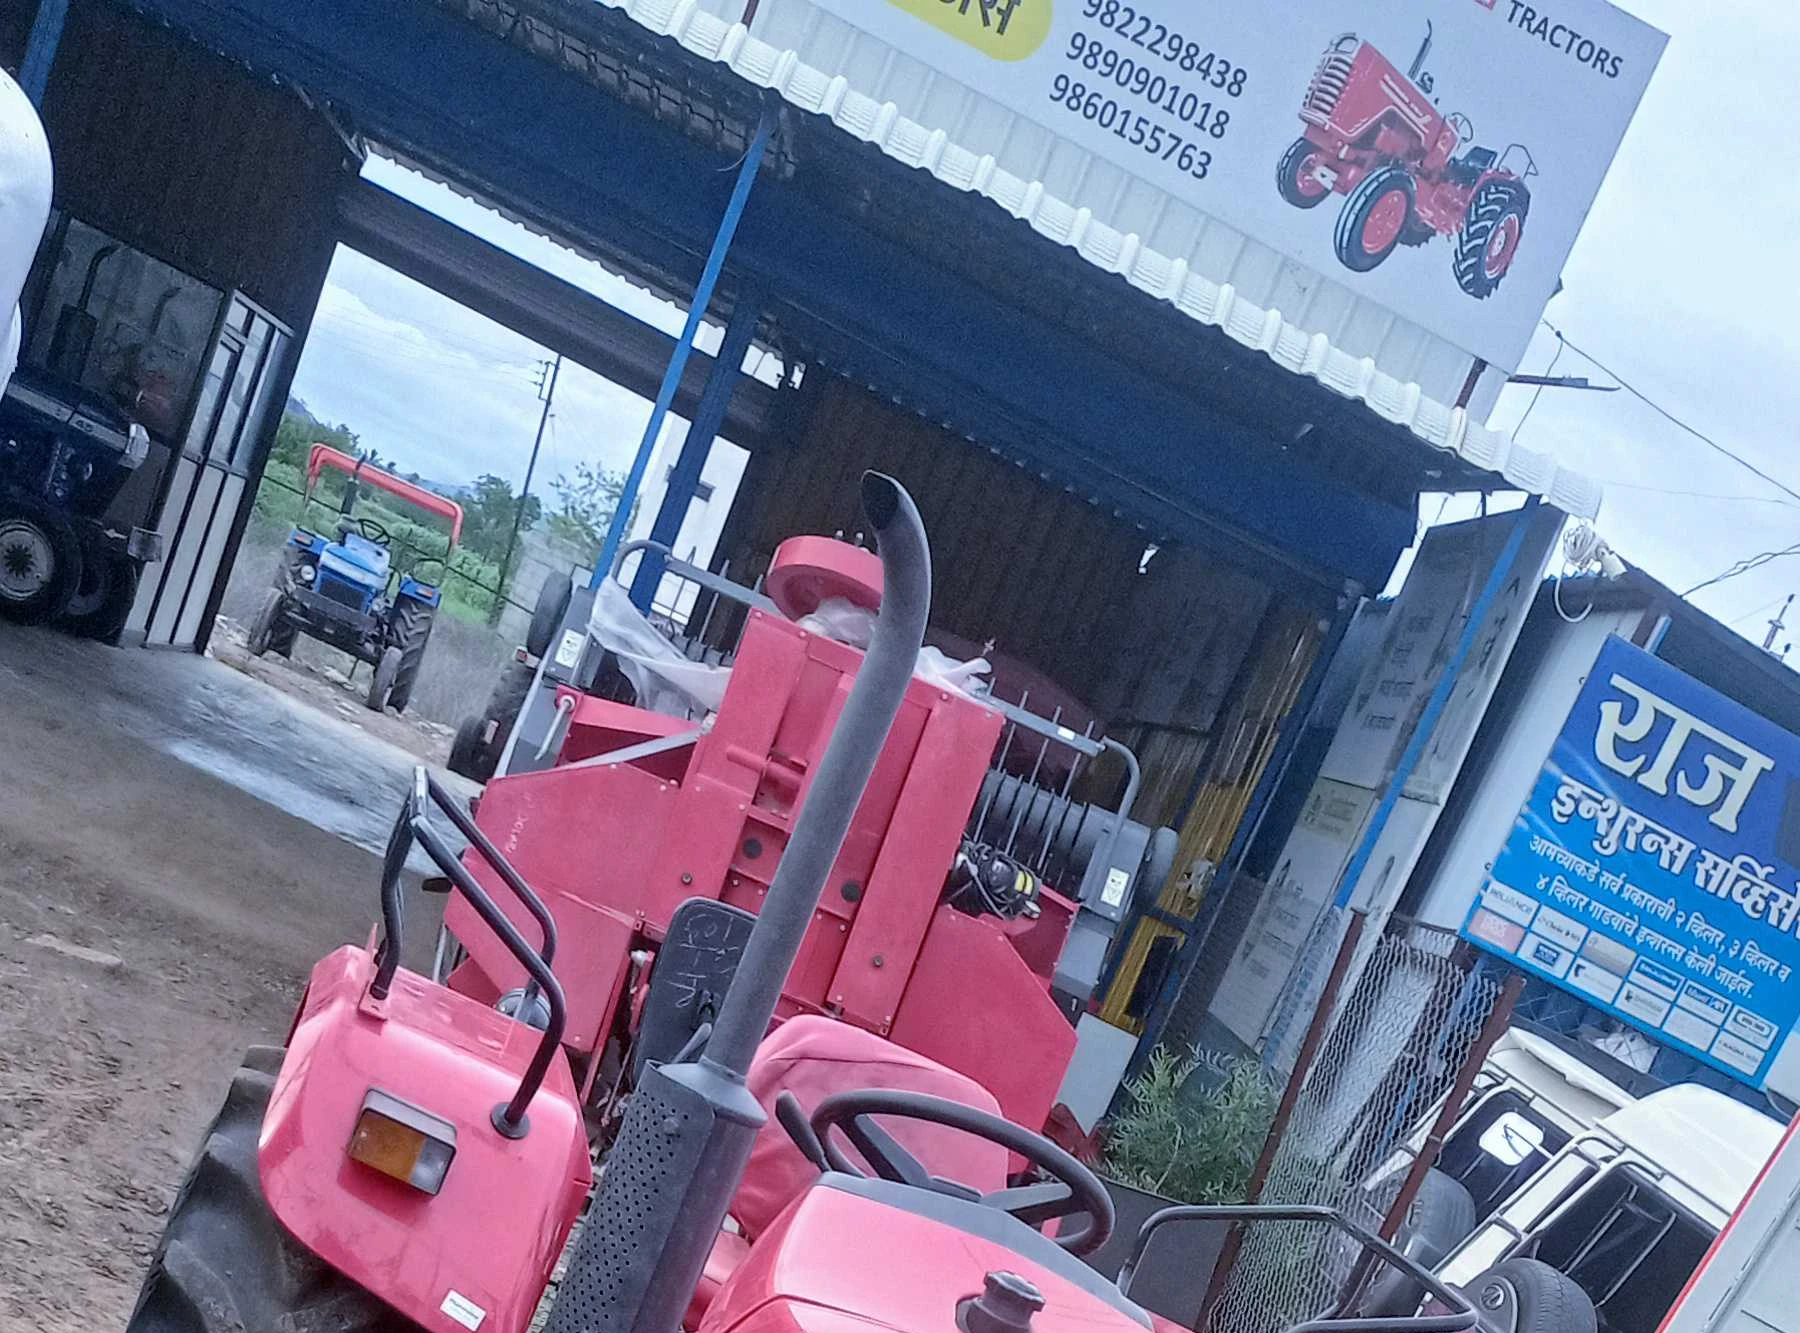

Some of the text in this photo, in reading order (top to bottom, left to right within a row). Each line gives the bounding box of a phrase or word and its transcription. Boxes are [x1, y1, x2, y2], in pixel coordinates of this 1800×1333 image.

[1065, 31, 1231, 140] 9890901018
[1082, 0, 1248, 98] 9822298438
[1507, 0, 1624, 79] TRACTORS
[1049, 73, 1213, 181] 9860155763
[1594, 672, 1776, 835] राज
[1550, 774, 1697, 876] इन्शुरन्स
[1528, 833, 1601, 884] आमच्याकडे
[1598, 870, 1627, 897] सर्व
[1674, 911, 1688, 930] २
[1728, 938, 1742, 960] ३
[1739, 940, 1781, 977] व्हिलर
[1777, 964, 1793, 984] व
[1535, 873, 1549, 891] ४
[1548, 873, 1591, 912] व्हिलर
[1684, 945, 1717, 978] केली
